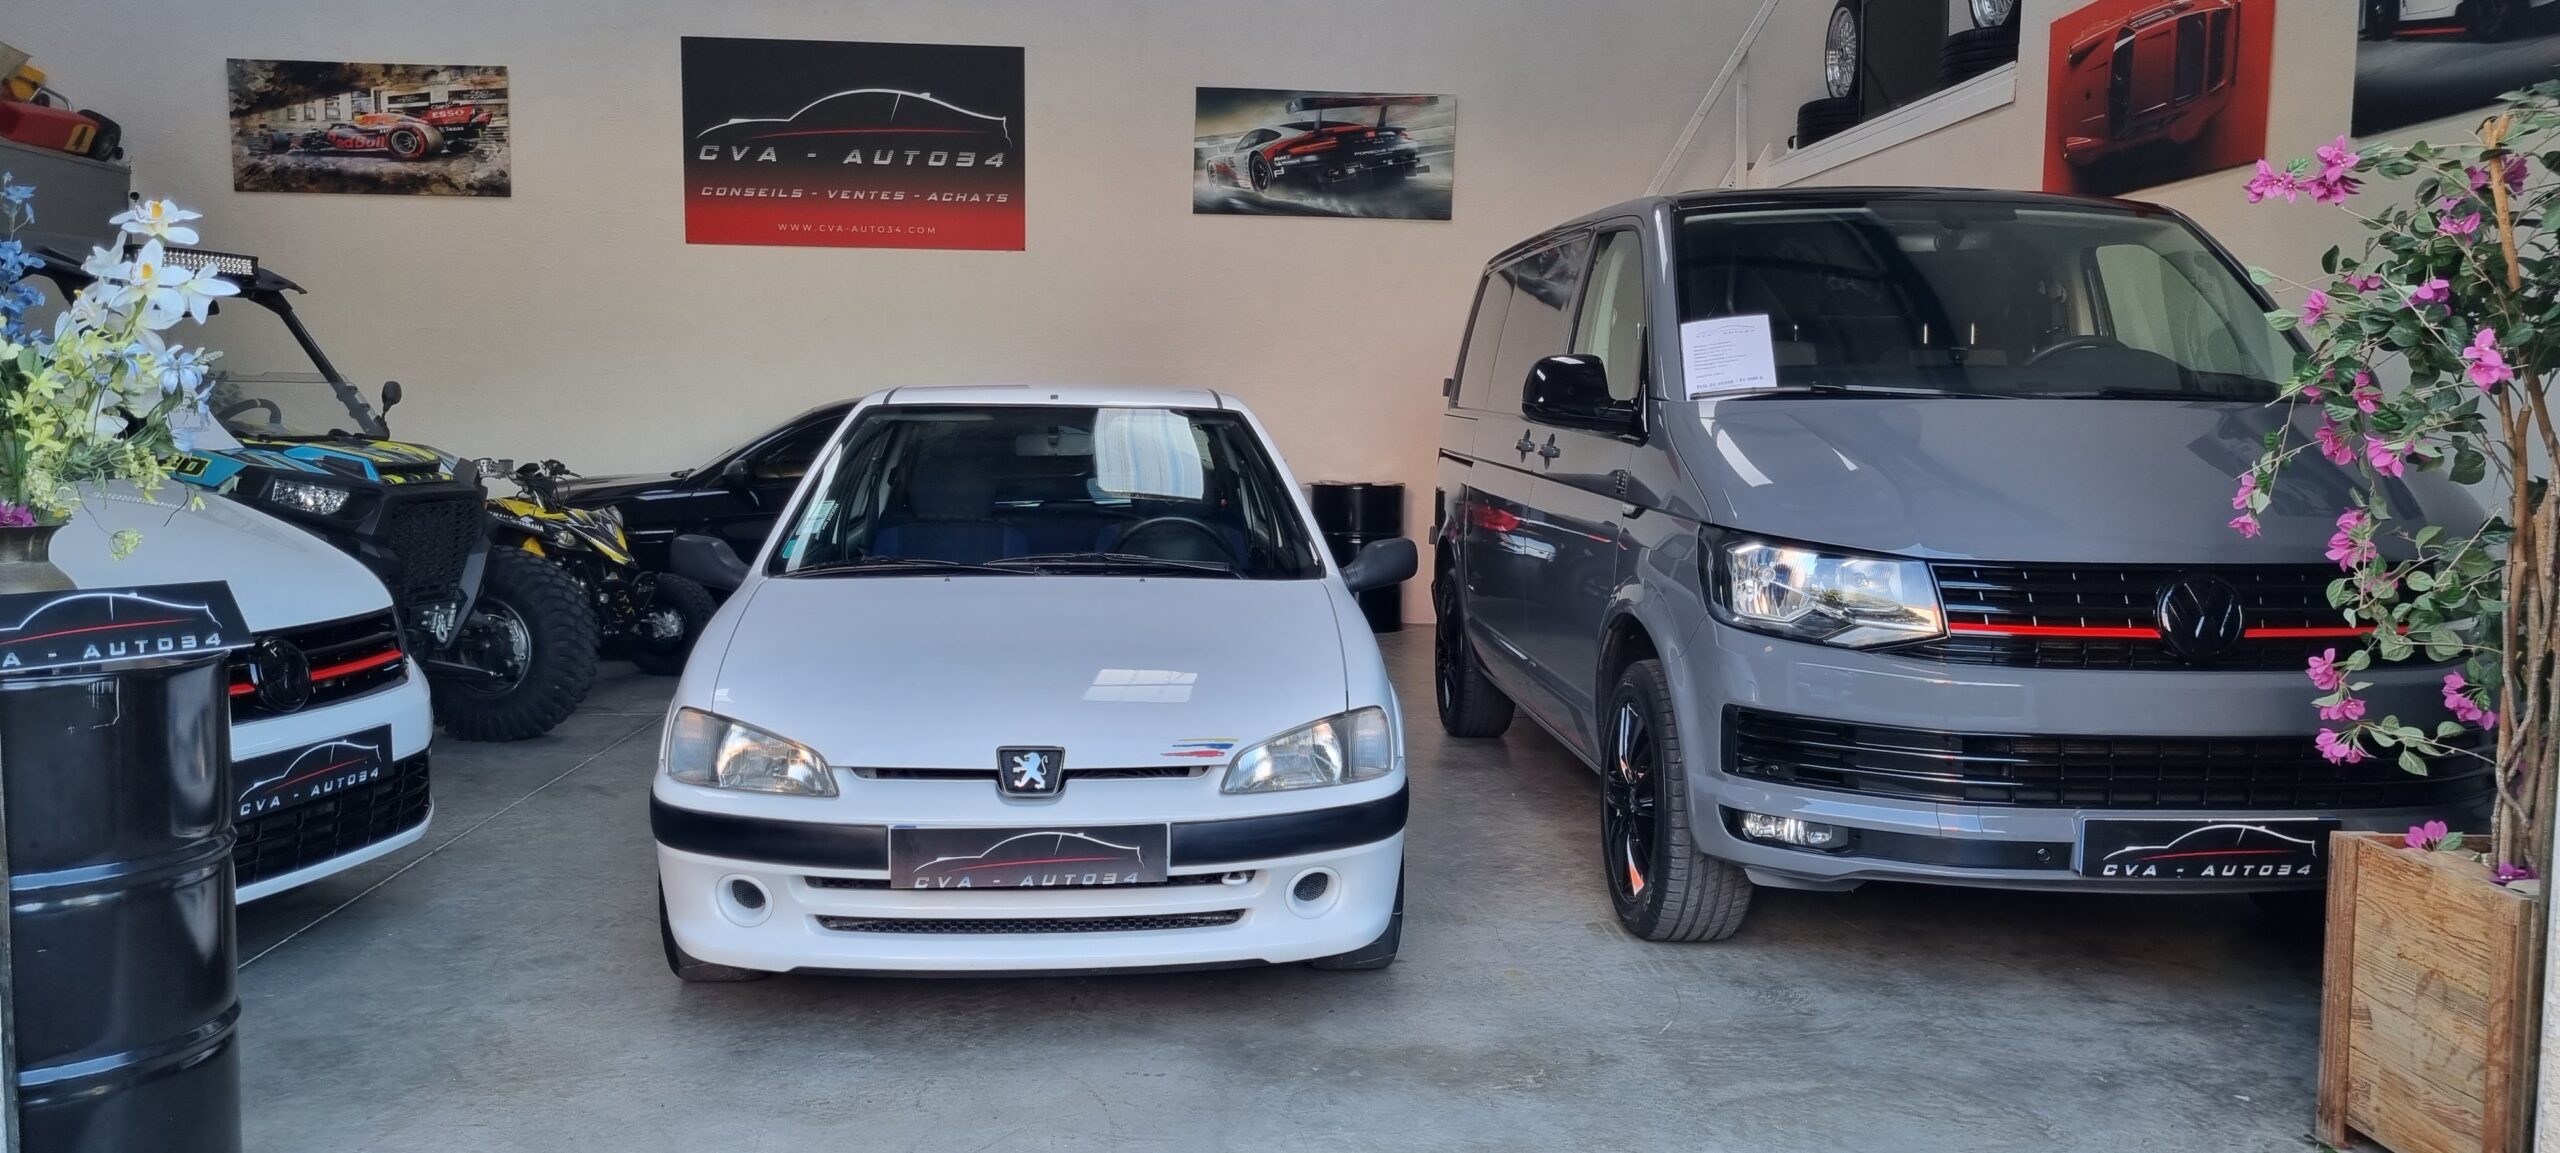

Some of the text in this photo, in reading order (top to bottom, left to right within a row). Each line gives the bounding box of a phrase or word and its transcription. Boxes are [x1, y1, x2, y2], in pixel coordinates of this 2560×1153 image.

[431, 110, 465, 119] ESSO
[699, 145, 777, 162] CVA
[843, 149, 1004, 168] AUTO34
[701, 186, 803, 198] CONSEILS
[827, 189, 906, 201] VENTES
[927, 192, 1009, 203] ACHATS
[777, 223, 937, 235] WWW.CVA-AUTO34.COM
[83, 632, 222, 660] AUTO34
[240, 796, 281, 817] CVA
[310, 766, 380, 797] AUTO34
[2102, 864, 2158, 876] CVA
[2200, 864, 2312, 876] AUTO34
[914, 875, 972, 889] CVA
[1020, 871, 1139, 887] AUTO34
